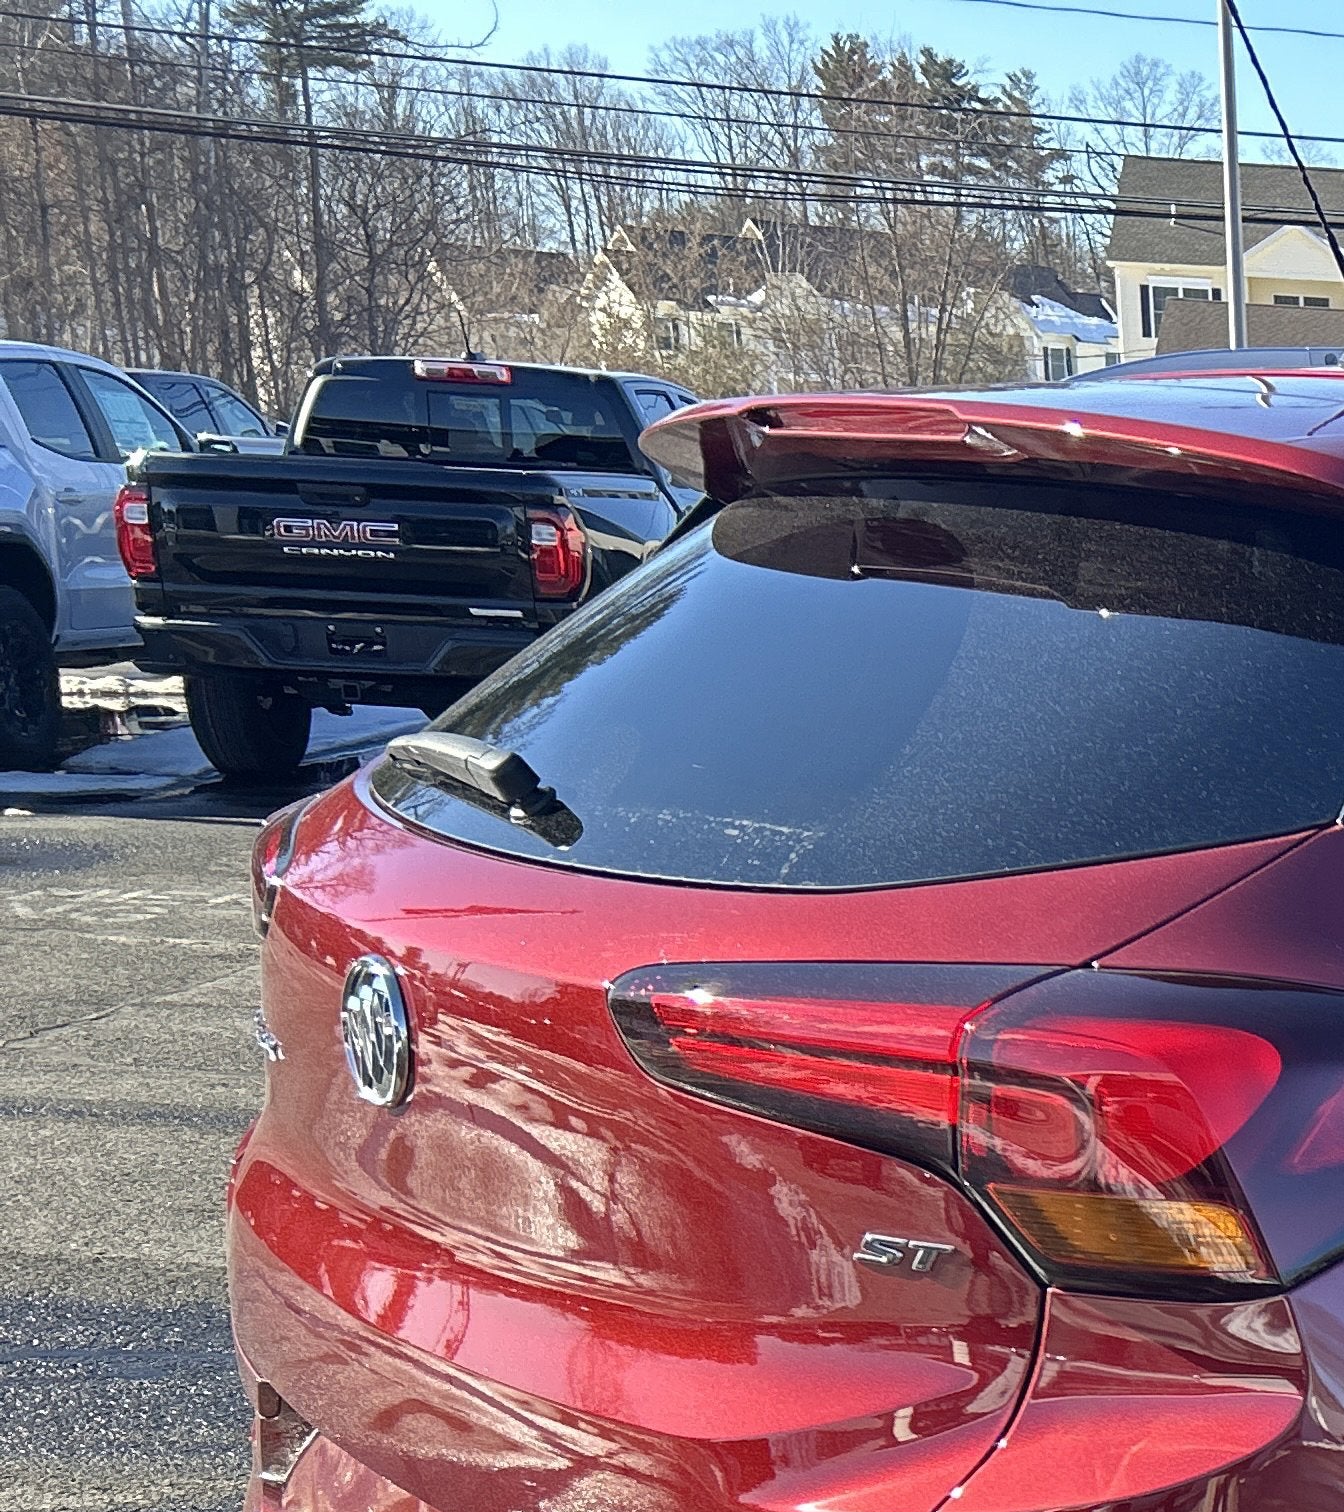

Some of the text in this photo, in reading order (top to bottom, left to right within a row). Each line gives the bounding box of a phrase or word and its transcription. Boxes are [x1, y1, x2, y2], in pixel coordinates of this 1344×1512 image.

[273, 517, 400, 545] GMC
[283, 546, 395, 560] CANYON
[852, 1231, 956, 1273] ST
